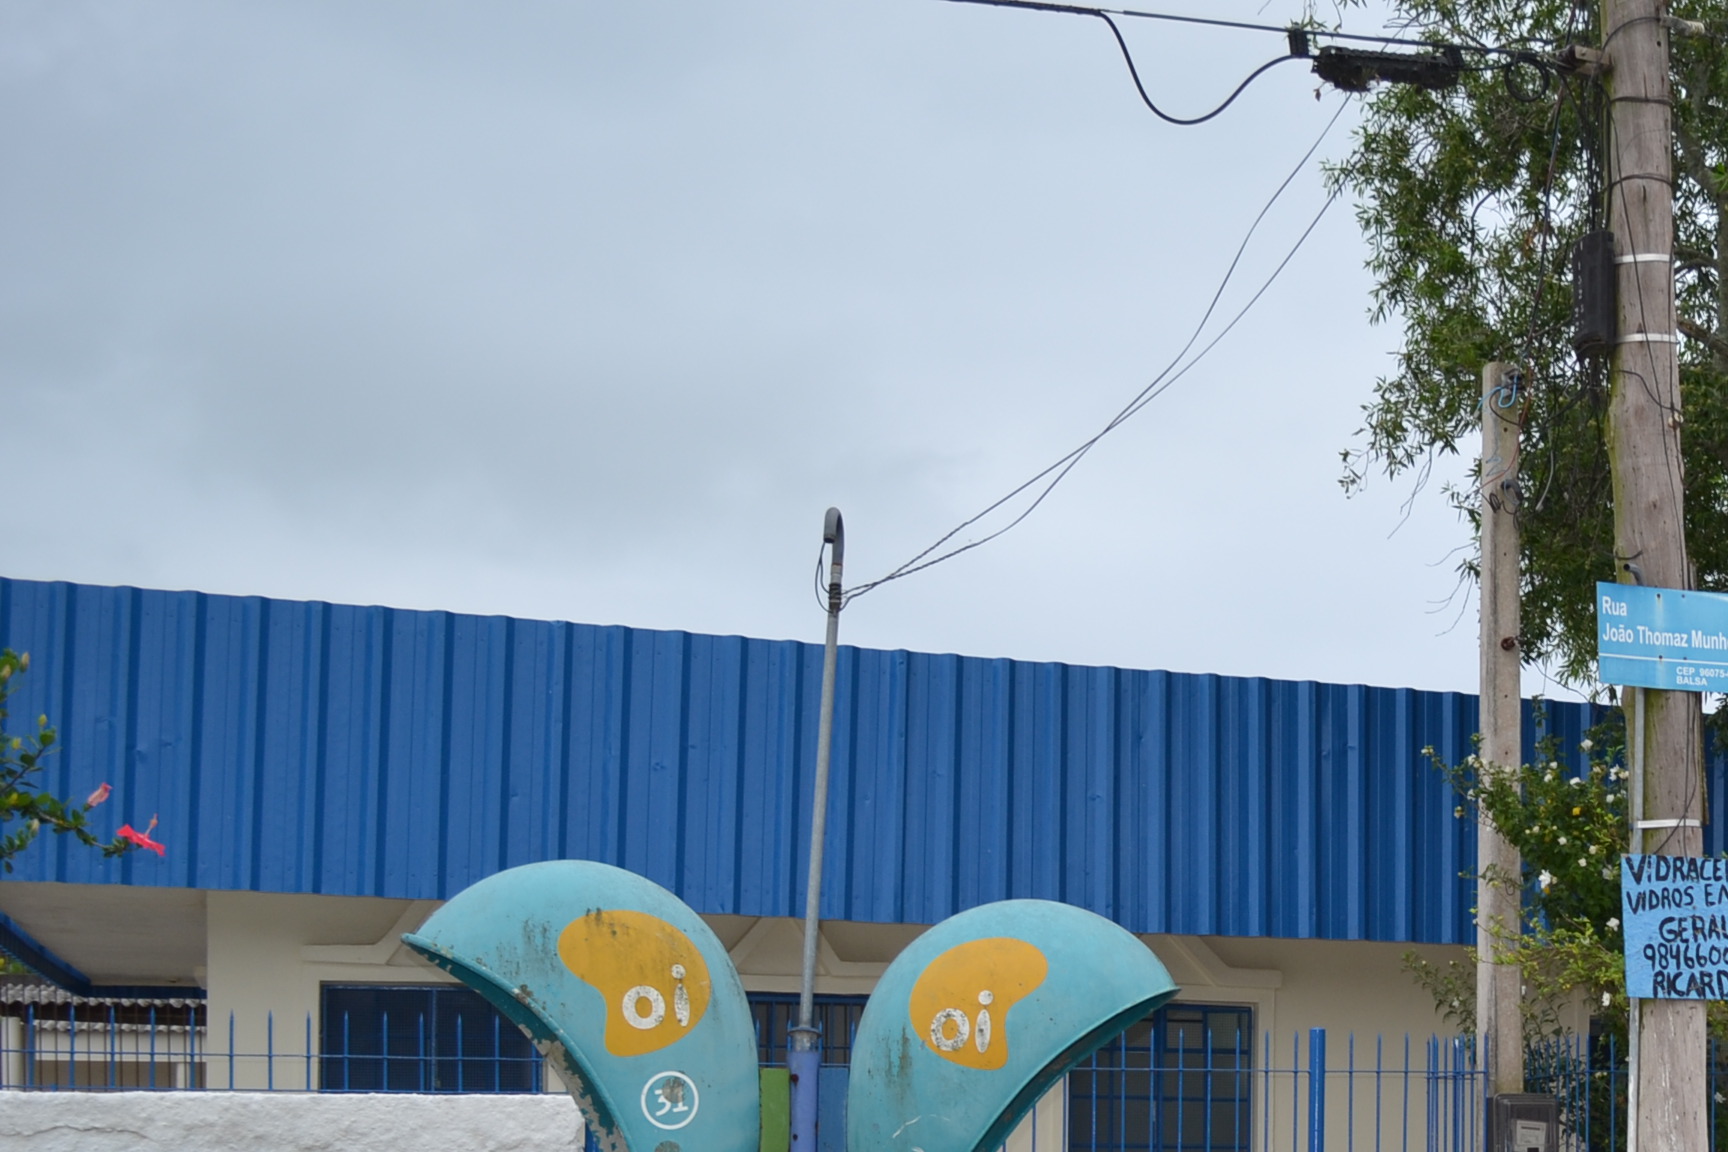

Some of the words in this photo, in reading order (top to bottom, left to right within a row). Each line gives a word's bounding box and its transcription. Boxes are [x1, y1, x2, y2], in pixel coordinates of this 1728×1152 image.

[1602, 596, 1627, 617] Rua
[1602, 622, 1634, 643] João
[1636, 625, 1688, 647] Thomaz
[1676, 666, 1695, 676] CEP
[1676, 675, 1708, 686] BALSA
[1626, 885, 1695, 915] VIDROS
